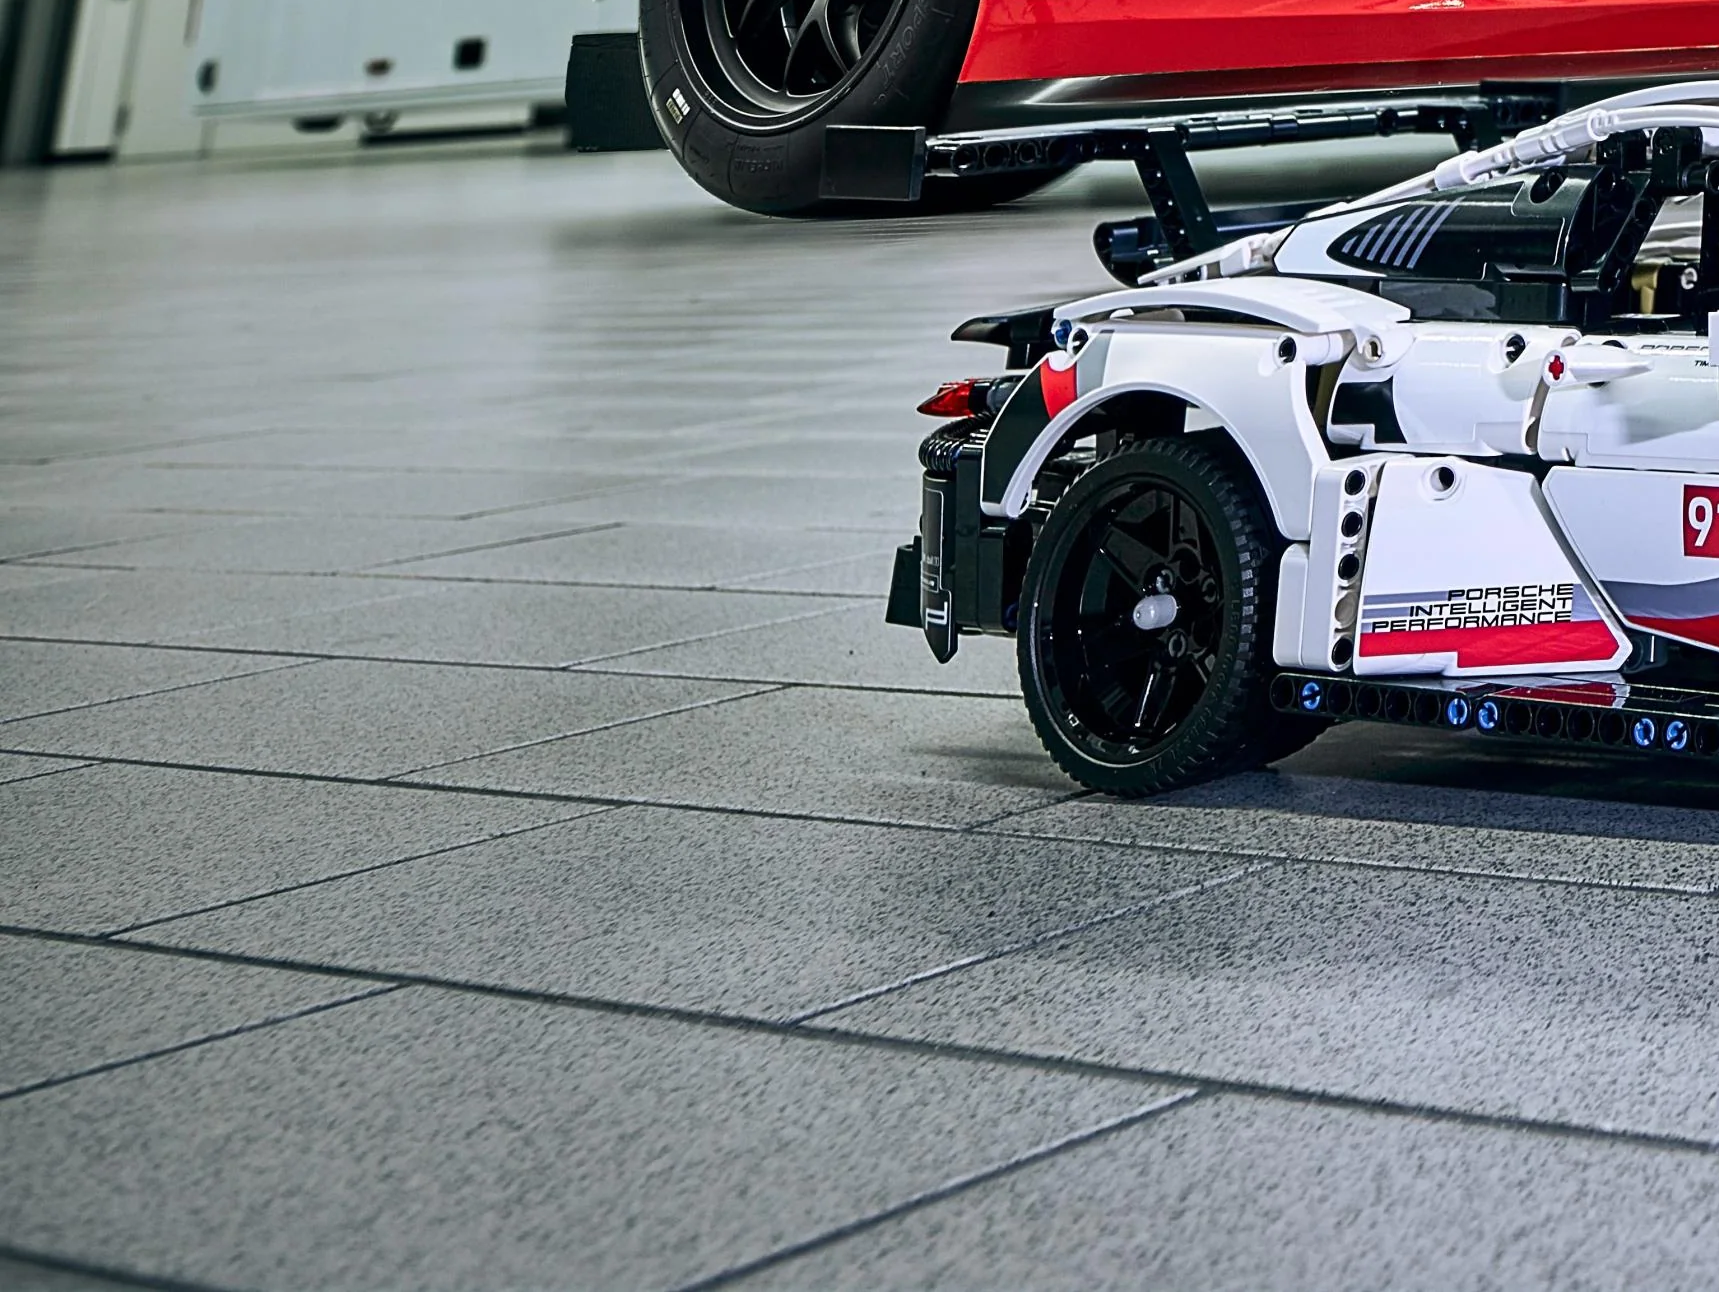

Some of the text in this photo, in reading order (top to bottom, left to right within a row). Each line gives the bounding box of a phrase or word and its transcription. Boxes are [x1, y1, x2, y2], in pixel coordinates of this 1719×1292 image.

[1447, 582, 1575, 602] PORSCHE
[1409, 597, 1573, 618] INTELLIGENT
[1371, 611, 1572, 633] PERFORMANCE
